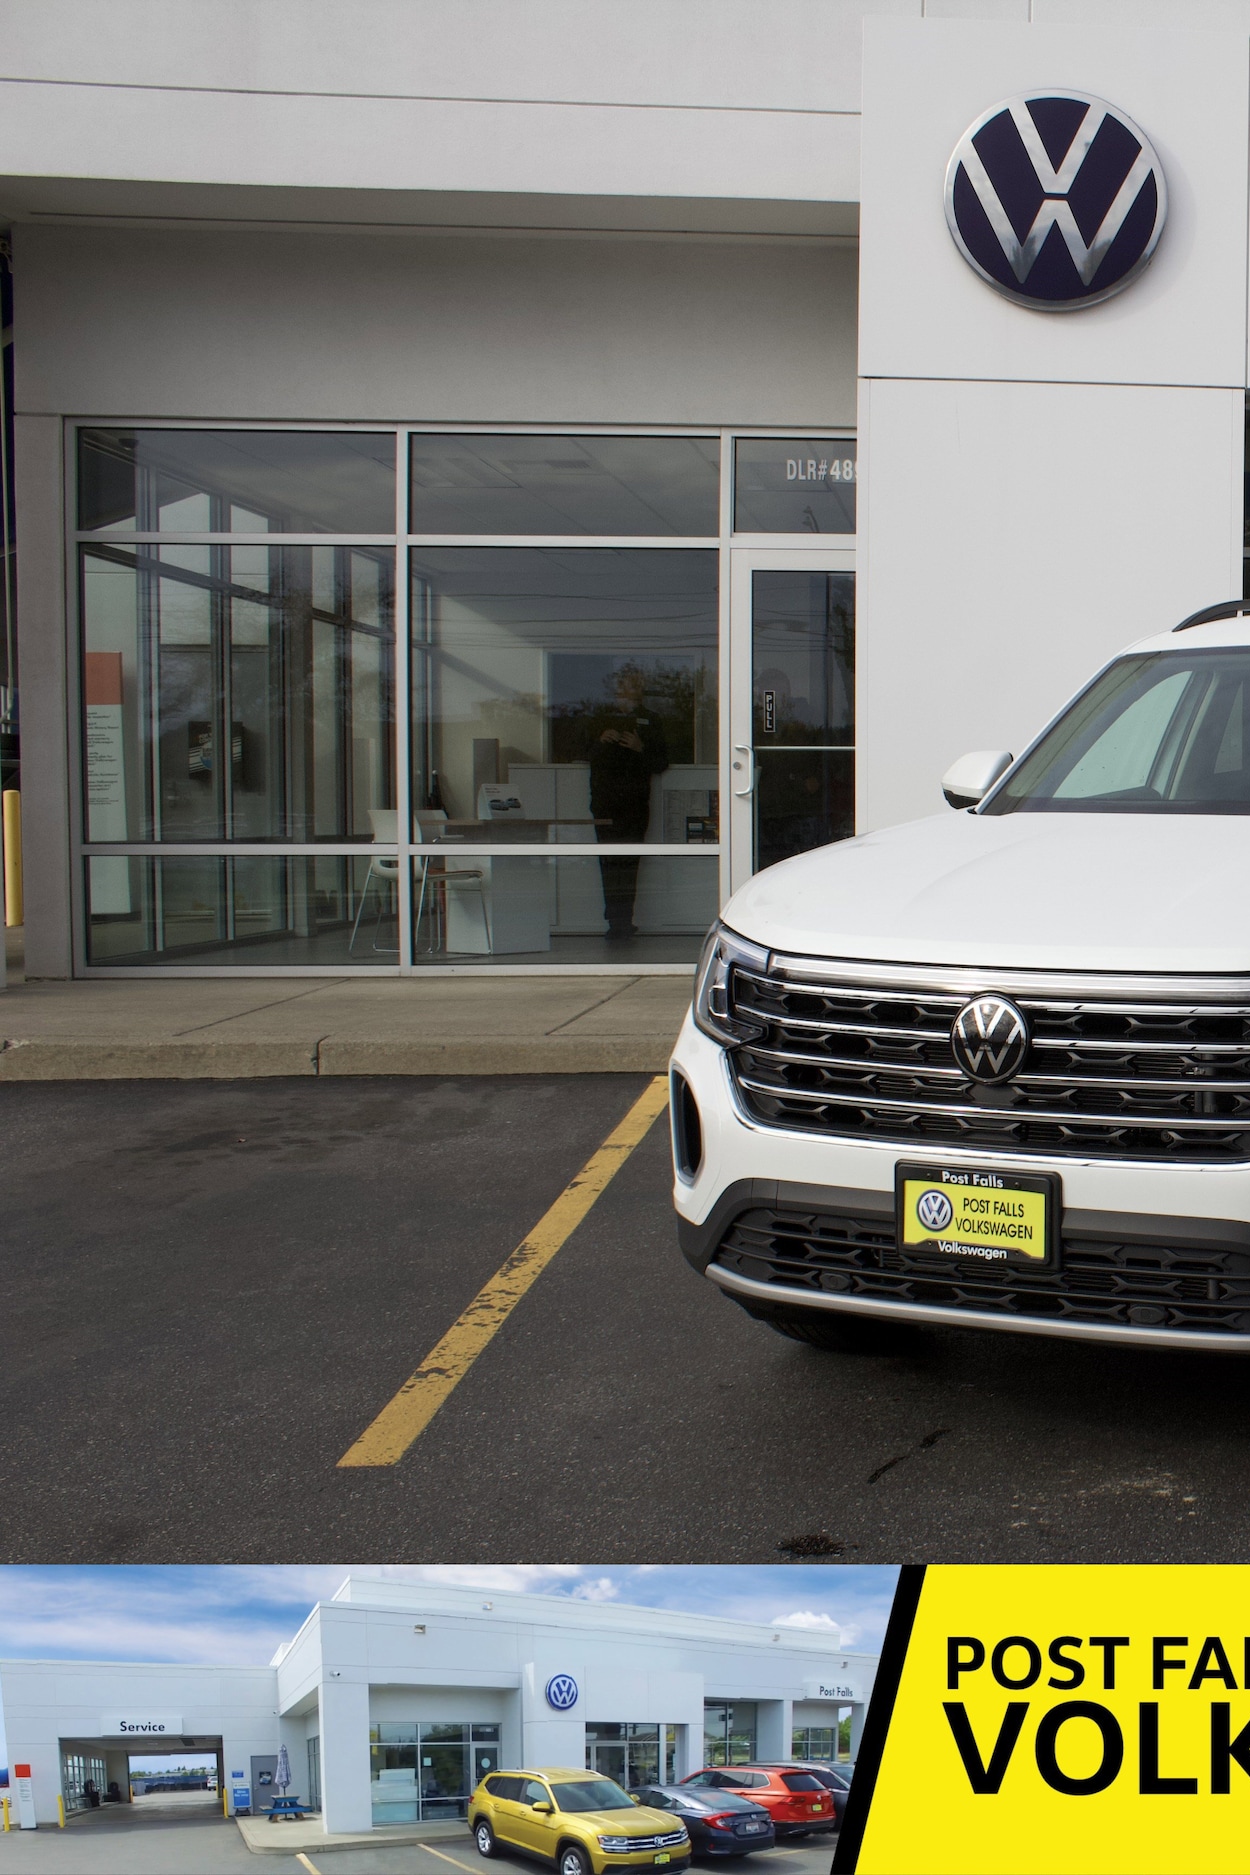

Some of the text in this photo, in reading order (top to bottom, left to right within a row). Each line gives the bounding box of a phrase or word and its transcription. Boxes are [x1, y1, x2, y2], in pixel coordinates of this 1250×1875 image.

[786, 459, 857, 481] DLR#48
[941, 1170, 1004, 1189] Post Falls
[963, 1198, 1025, 1218] POST FALLS
[955, 1217, 1033, 1240] VOLKSWAGEN
[937, 1240, 1007, 1260] Volkswagen
